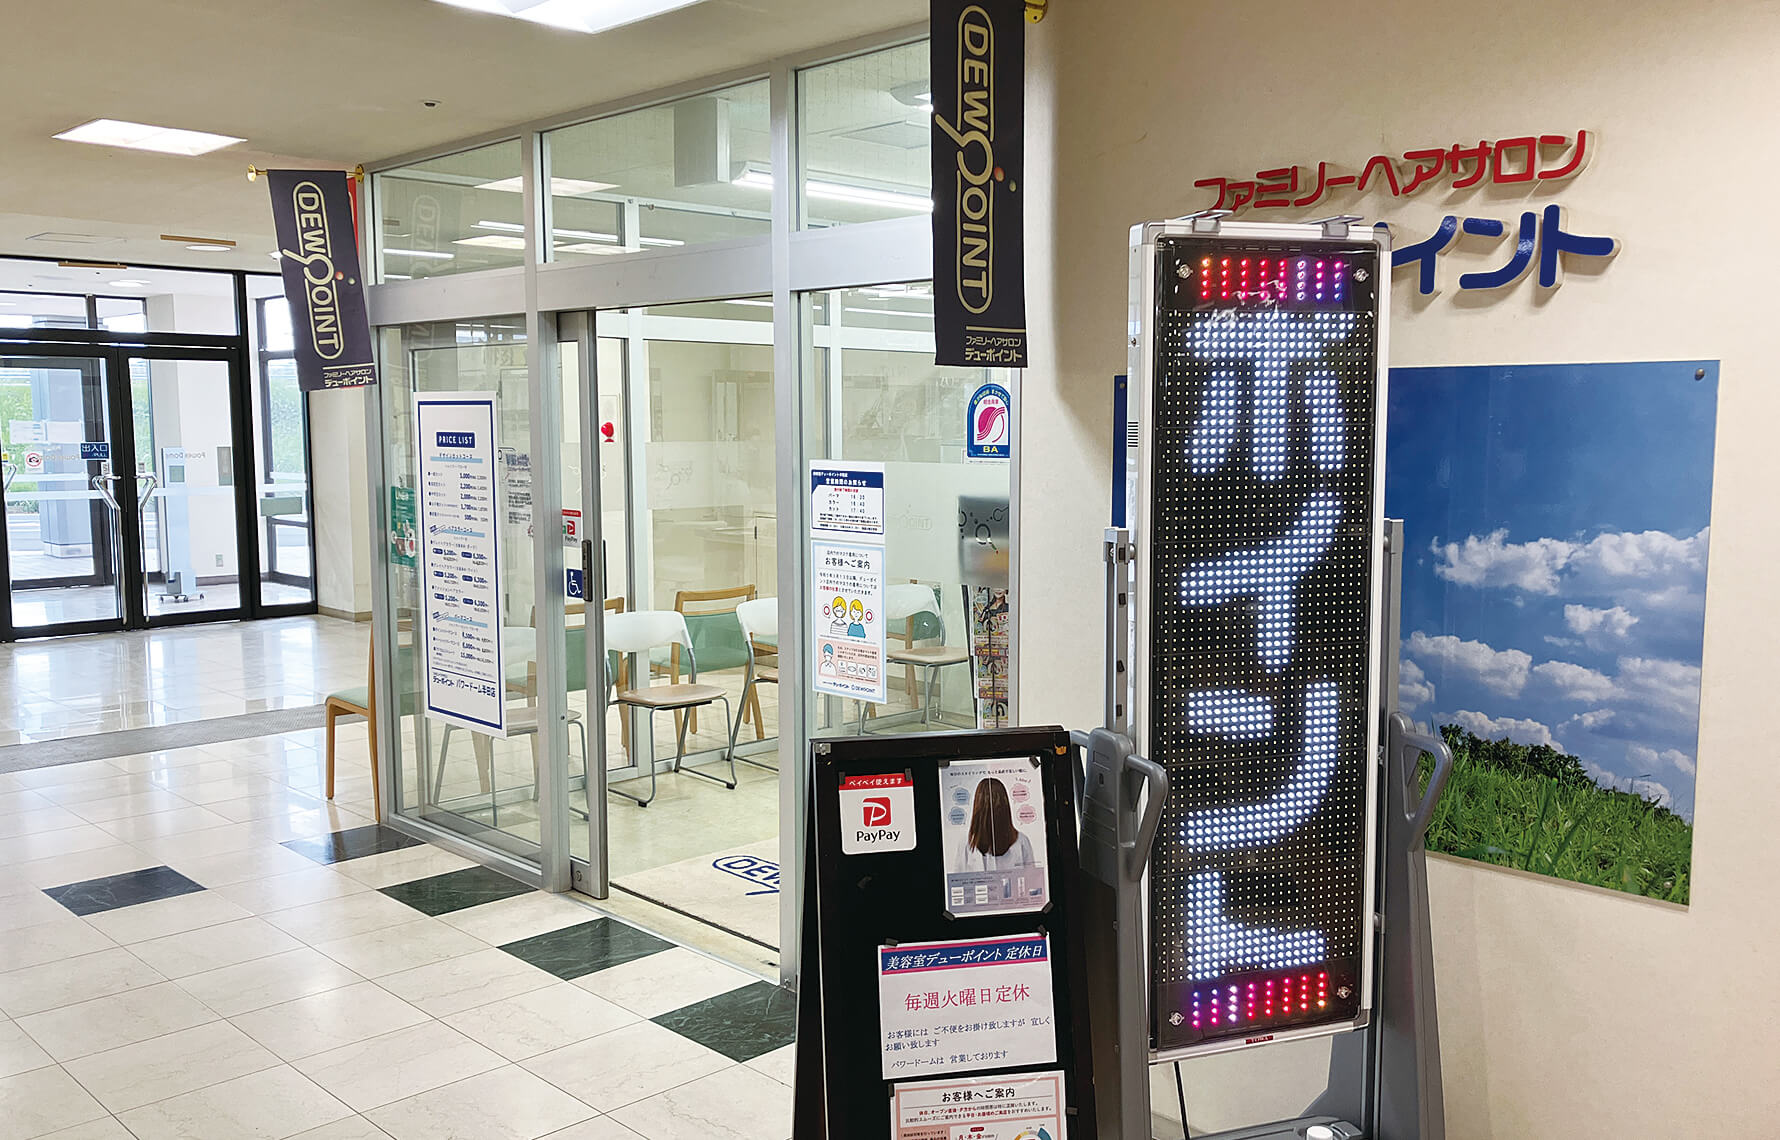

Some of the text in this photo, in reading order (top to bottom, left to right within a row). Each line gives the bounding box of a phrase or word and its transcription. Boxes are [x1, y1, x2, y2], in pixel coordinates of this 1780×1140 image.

[1194, 130, 1586, 214] ファミリーヘアサロン
[1376, 204, 1614, 295] イント
[966, 336, 1022, 347] ファミリーヘアサロン
[965, 348, 1023, 362] デューポイント
[323, 369, 372, 379] ファミリーヘアサロン
[324, 375, 374, 388] デューポイント
[439, 435, 473, 445] PRICE LIST
[81, 444, 108, 453] 出入口
[983, 445, 999, 453] BA
[825, 557, 871, 570] お客様へご案内
[1180, 312, 1354, 980] ポイント
[849, 778, 902, 787] ペイペイ使えます
[856, 829, 901, 844] PayPay
[886, 945, 1043, 971] 美容室デューポイント 定休日
[904, 983, 1031, 1012] 毎週火曜日定休
[887, 1016, 1051, 1040] お客様には ご不便をお掛け致しますが 宜しく
[885, 1038, 940, 1051] お願い致します
[891, 1050, 1009, 1069] パワードームは 営業しております
[942, 1087, 1015, 1102] お客様へご案内
